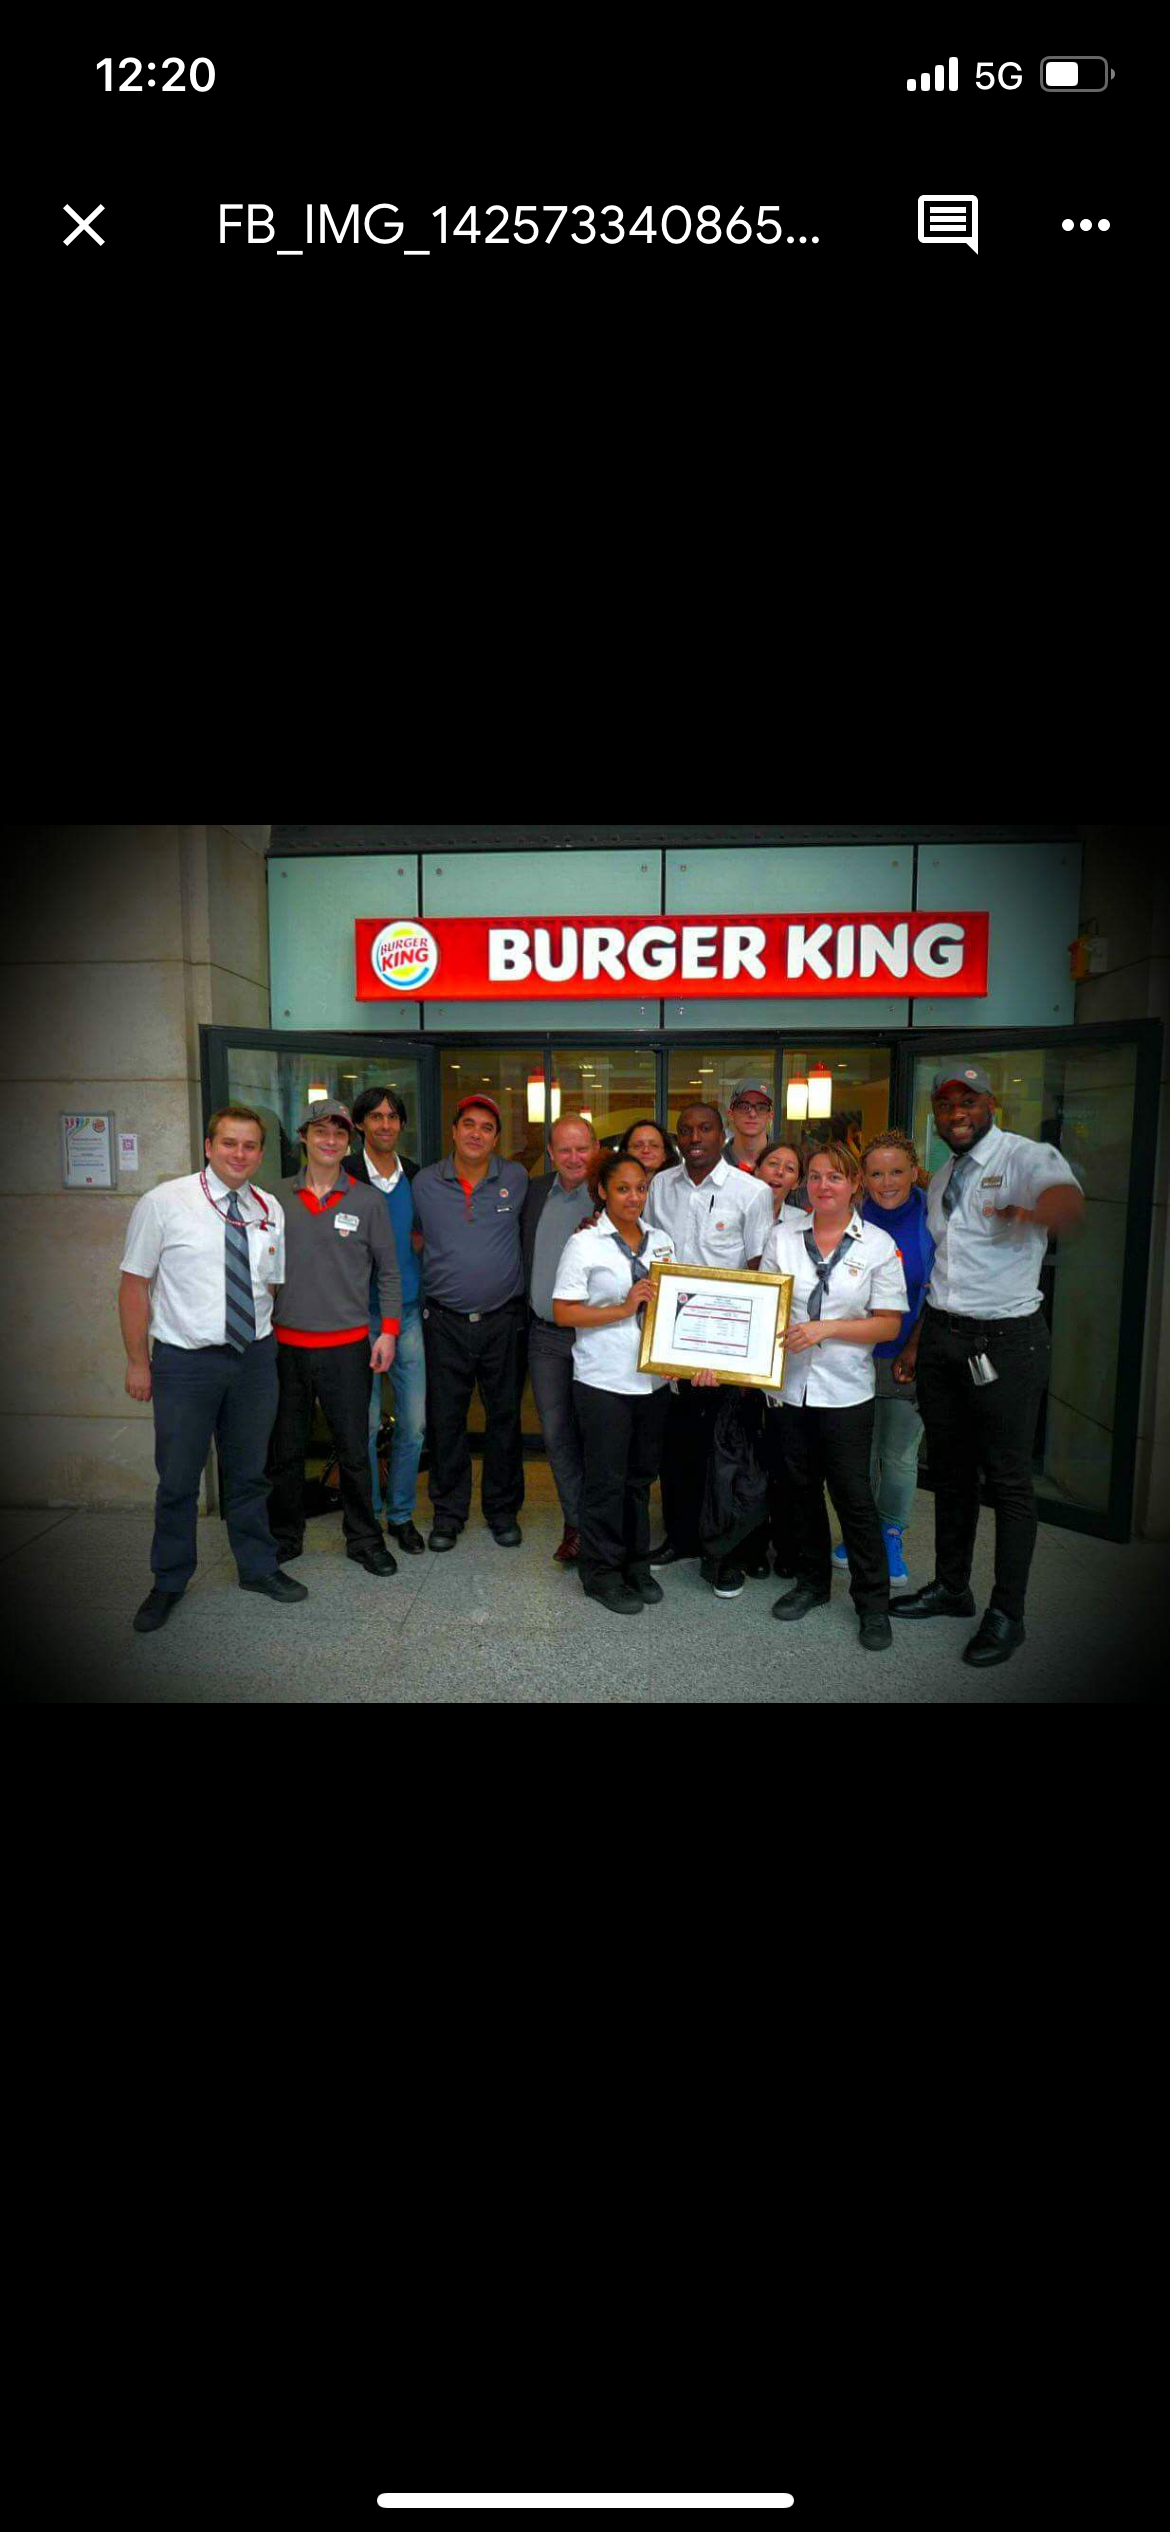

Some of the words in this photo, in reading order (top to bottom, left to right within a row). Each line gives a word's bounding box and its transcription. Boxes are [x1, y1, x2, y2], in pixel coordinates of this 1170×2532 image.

[380, 937, 428, 956] BURGER
[488, 925, 767, 982] BURGER
[786, 922, 966, 980] KING
[381, 947, 429, 972] KING
